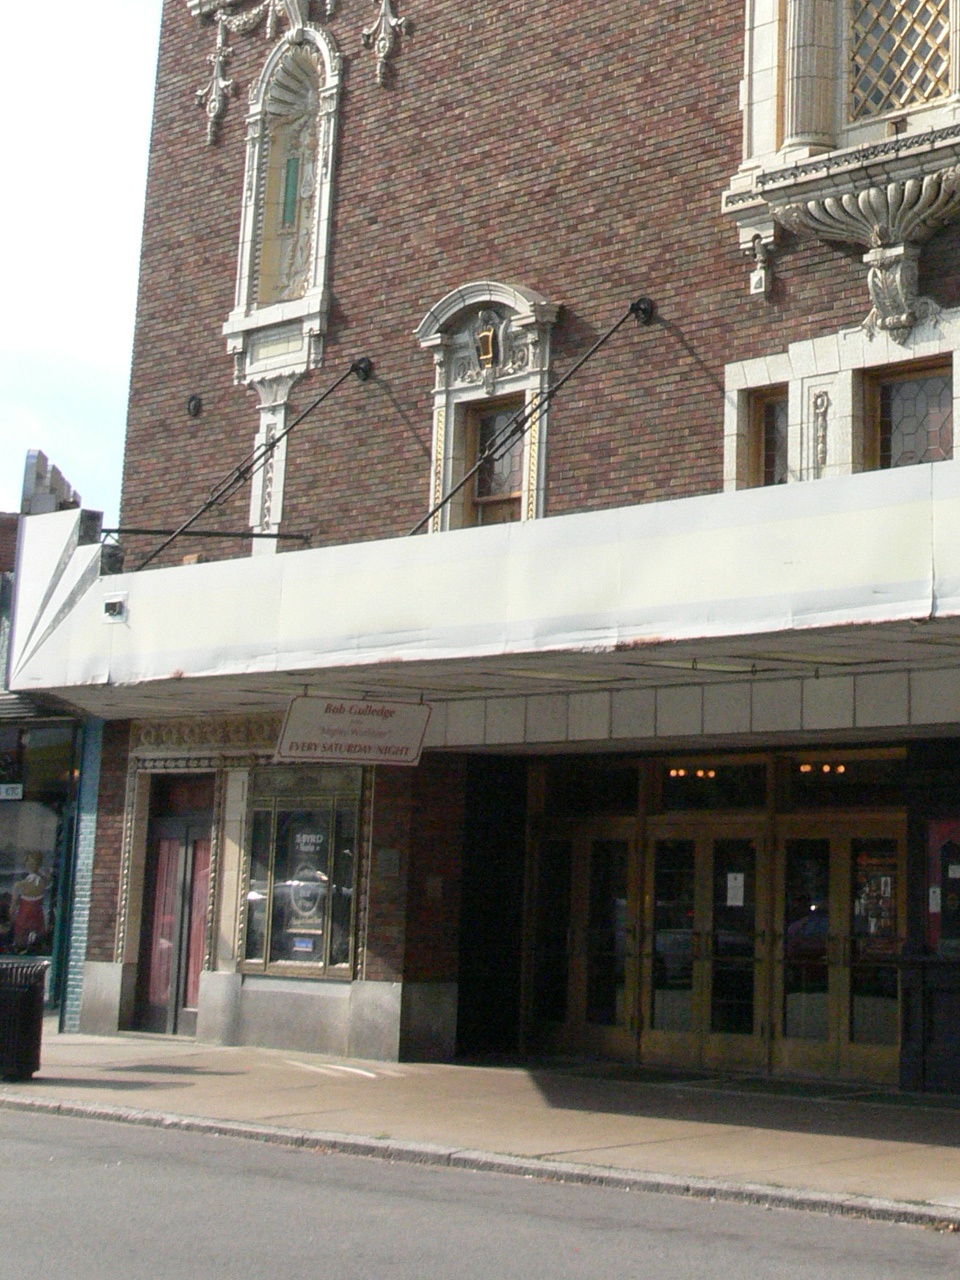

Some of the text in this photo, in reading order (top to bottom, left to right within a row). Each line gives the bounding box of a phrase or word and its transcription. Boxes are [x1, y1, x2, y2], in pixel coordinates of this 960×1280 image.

[325, 702, 396, 719] Bob Gulledge
[289, 741, 410, 756] EVERY SATURDAY NIGHT
